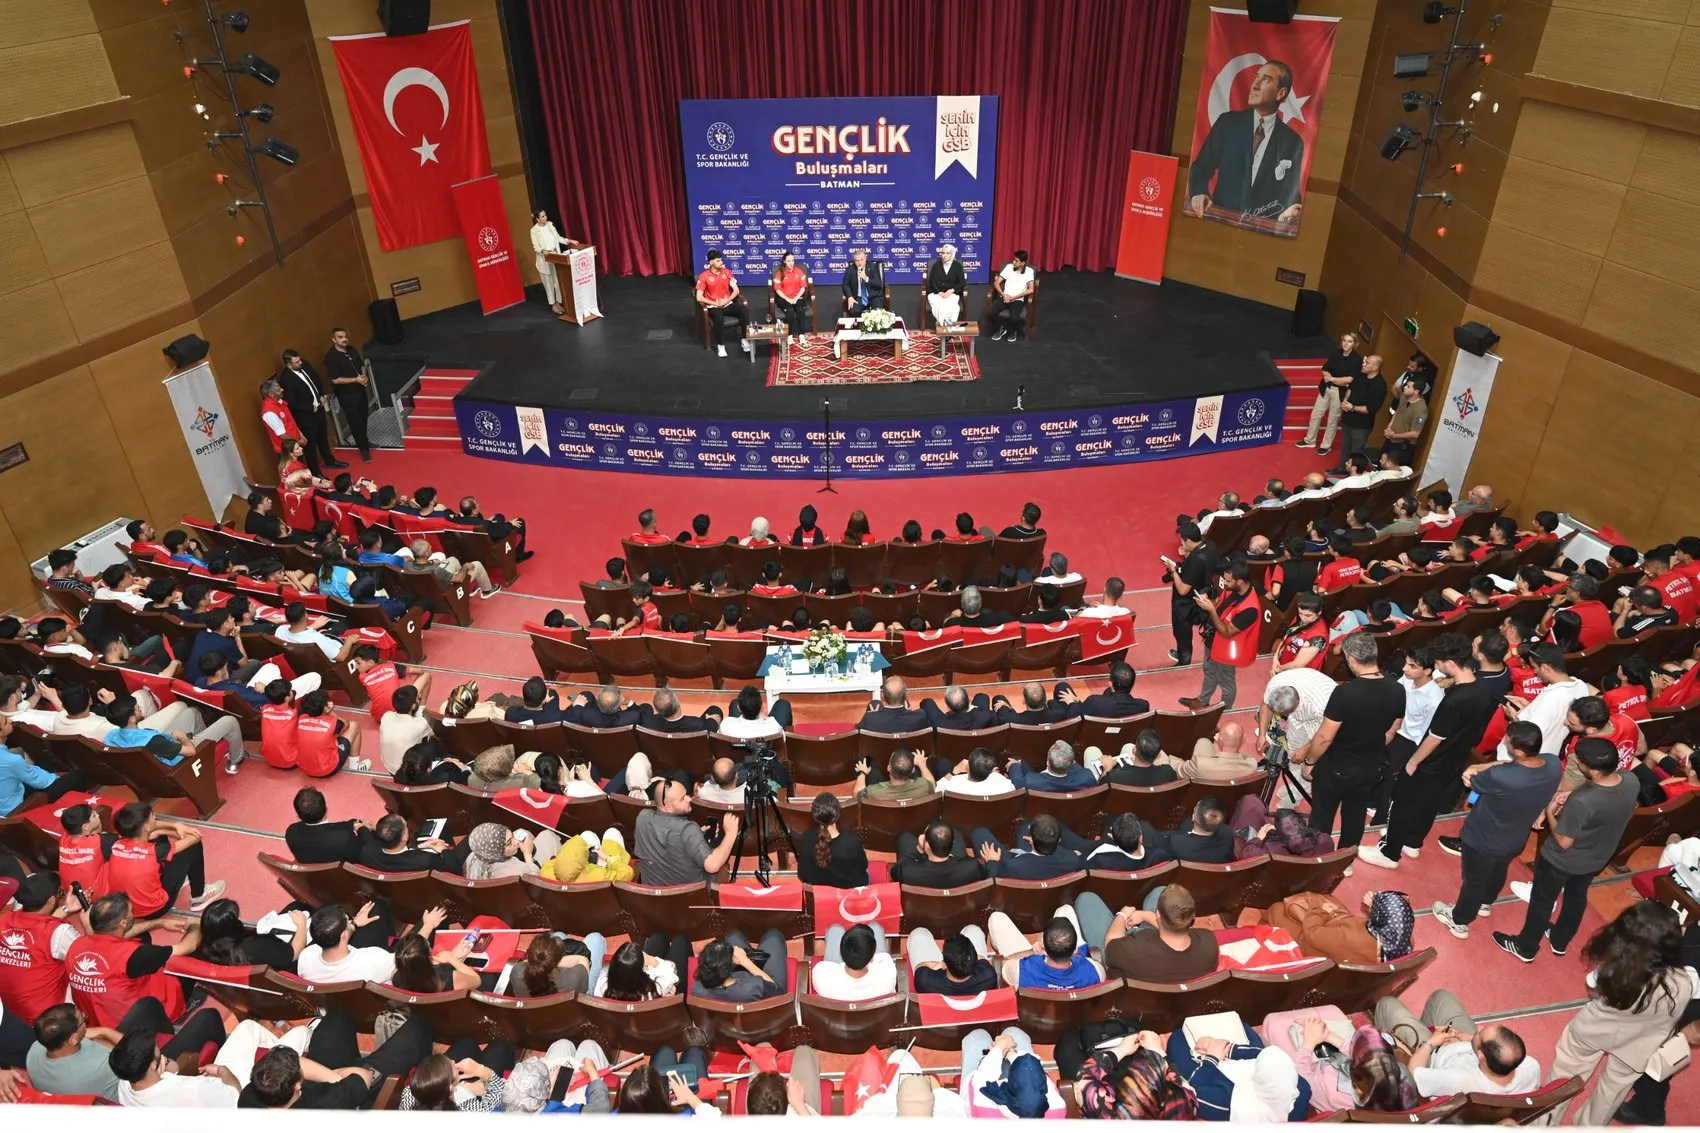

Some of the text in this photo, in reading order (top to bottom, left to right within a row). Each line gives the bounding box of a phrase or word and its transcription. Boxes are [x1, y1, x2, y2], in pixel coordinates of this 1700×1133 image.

[941, 110, 976, 124] SENİN
[946, 124, 969, 138] İÇİN
[772, 116, 911, 161] GENÇLİK
[942, 137, 972, 153] GSB
[710, 152, 738, 162] GENÇLİK
[714, 160, 750, 168] BAKANLIĞI
[796, 160, 888, 178] Buluşmaları
[820, 180, 860, 188] BATMAN
[1112, 412, 1149, 425] GENÇLİK
[1196, 419, 1214, 430] GSB
[588, 422, 625, 434] GENÇLİK
[961, 425, 1000, 436] GENÇLİK
[1040, 419, 1078, 431] GENÇLİK
[1236, 426, 1262, 435] GENÇLİK
[1444, 419, 1475, 437] BATMAN
[524, 430, 542, 440] GSB
[659, 427, 696, 438] GENÇLİK
[732, 430, 770, 440] GENÇLİK
[882, 428, 921, 439] GENÇLİK
[1146, 432, 1181, 444] GENÇLİK
[1239, 431, 1272, 441] BAKANLIĞI
[196, 434, 229, 455] BATMAN
[480, 438, 506, 448] GENÇLİK
[559, 442, 595, 455] GENÇLİK
[1076, 440, 1112, 452] GENÇLİK
[485, 446, 517, 456] BAKANLIĞI
[628, 448, 664, 459] GENÇLİK
[698, 452, 736, 462] GENÇLİK
[920, 450, 959, 462] GENÇLİK
[1000, 446, 1038, 457] GENÇLİK
[771, 453, 810, 465] GENÇLİK
[846, 453, 885, 464] GENÇLİK
[505, 541, 511, 554] A
[456, 586, 464, 600] B
[1670, 586, 1693, 598] BATMA
[1264, 609, 1271, 623] C
[406, 620, 415, 634] C
[1618, 697, 1639, 710] PETROL
[192, 758, 202, 778] F
[69, 973, 105, 987] GENÇLİK
